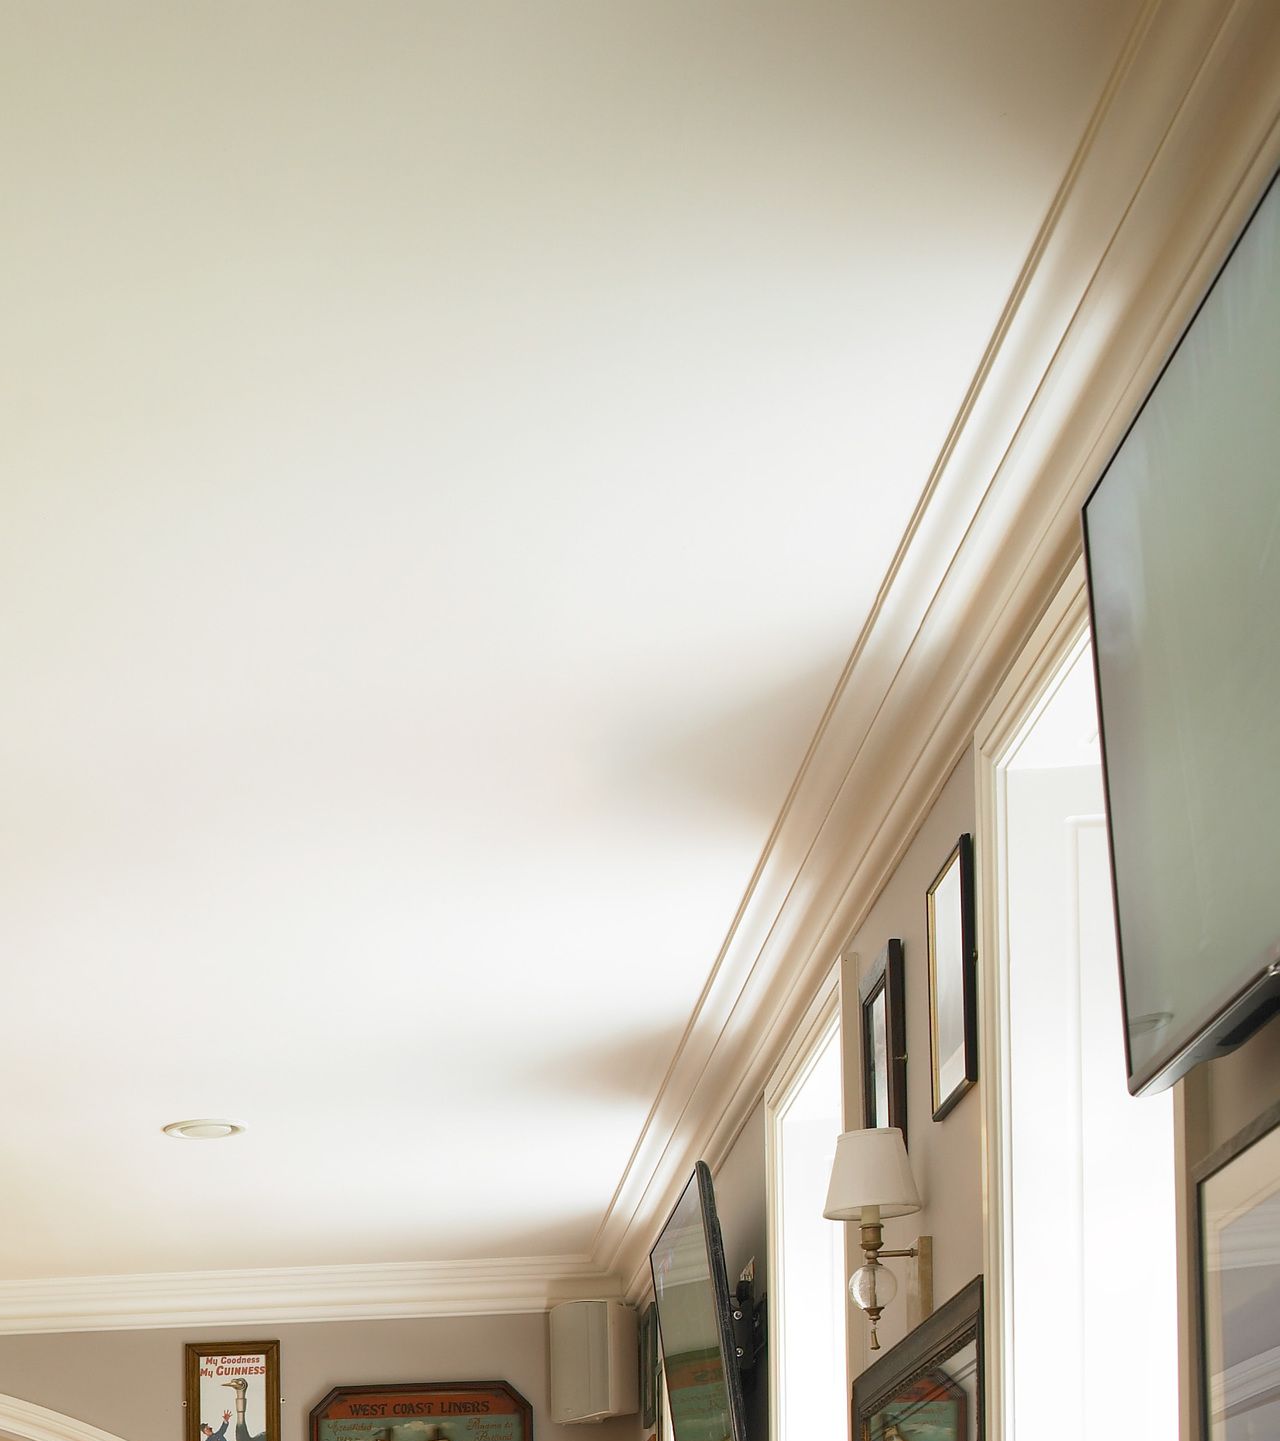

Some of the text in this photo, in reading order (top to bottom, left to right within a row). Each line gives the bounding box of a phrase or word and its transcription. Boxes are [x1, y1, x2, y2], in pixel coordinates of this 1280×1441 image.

[205, 1357, 260, 1366] My Goodness
[200, 1366, 266, 1378] My GUINNESS
[349, 1401, 490, 1416] WEST COAST LINERS
